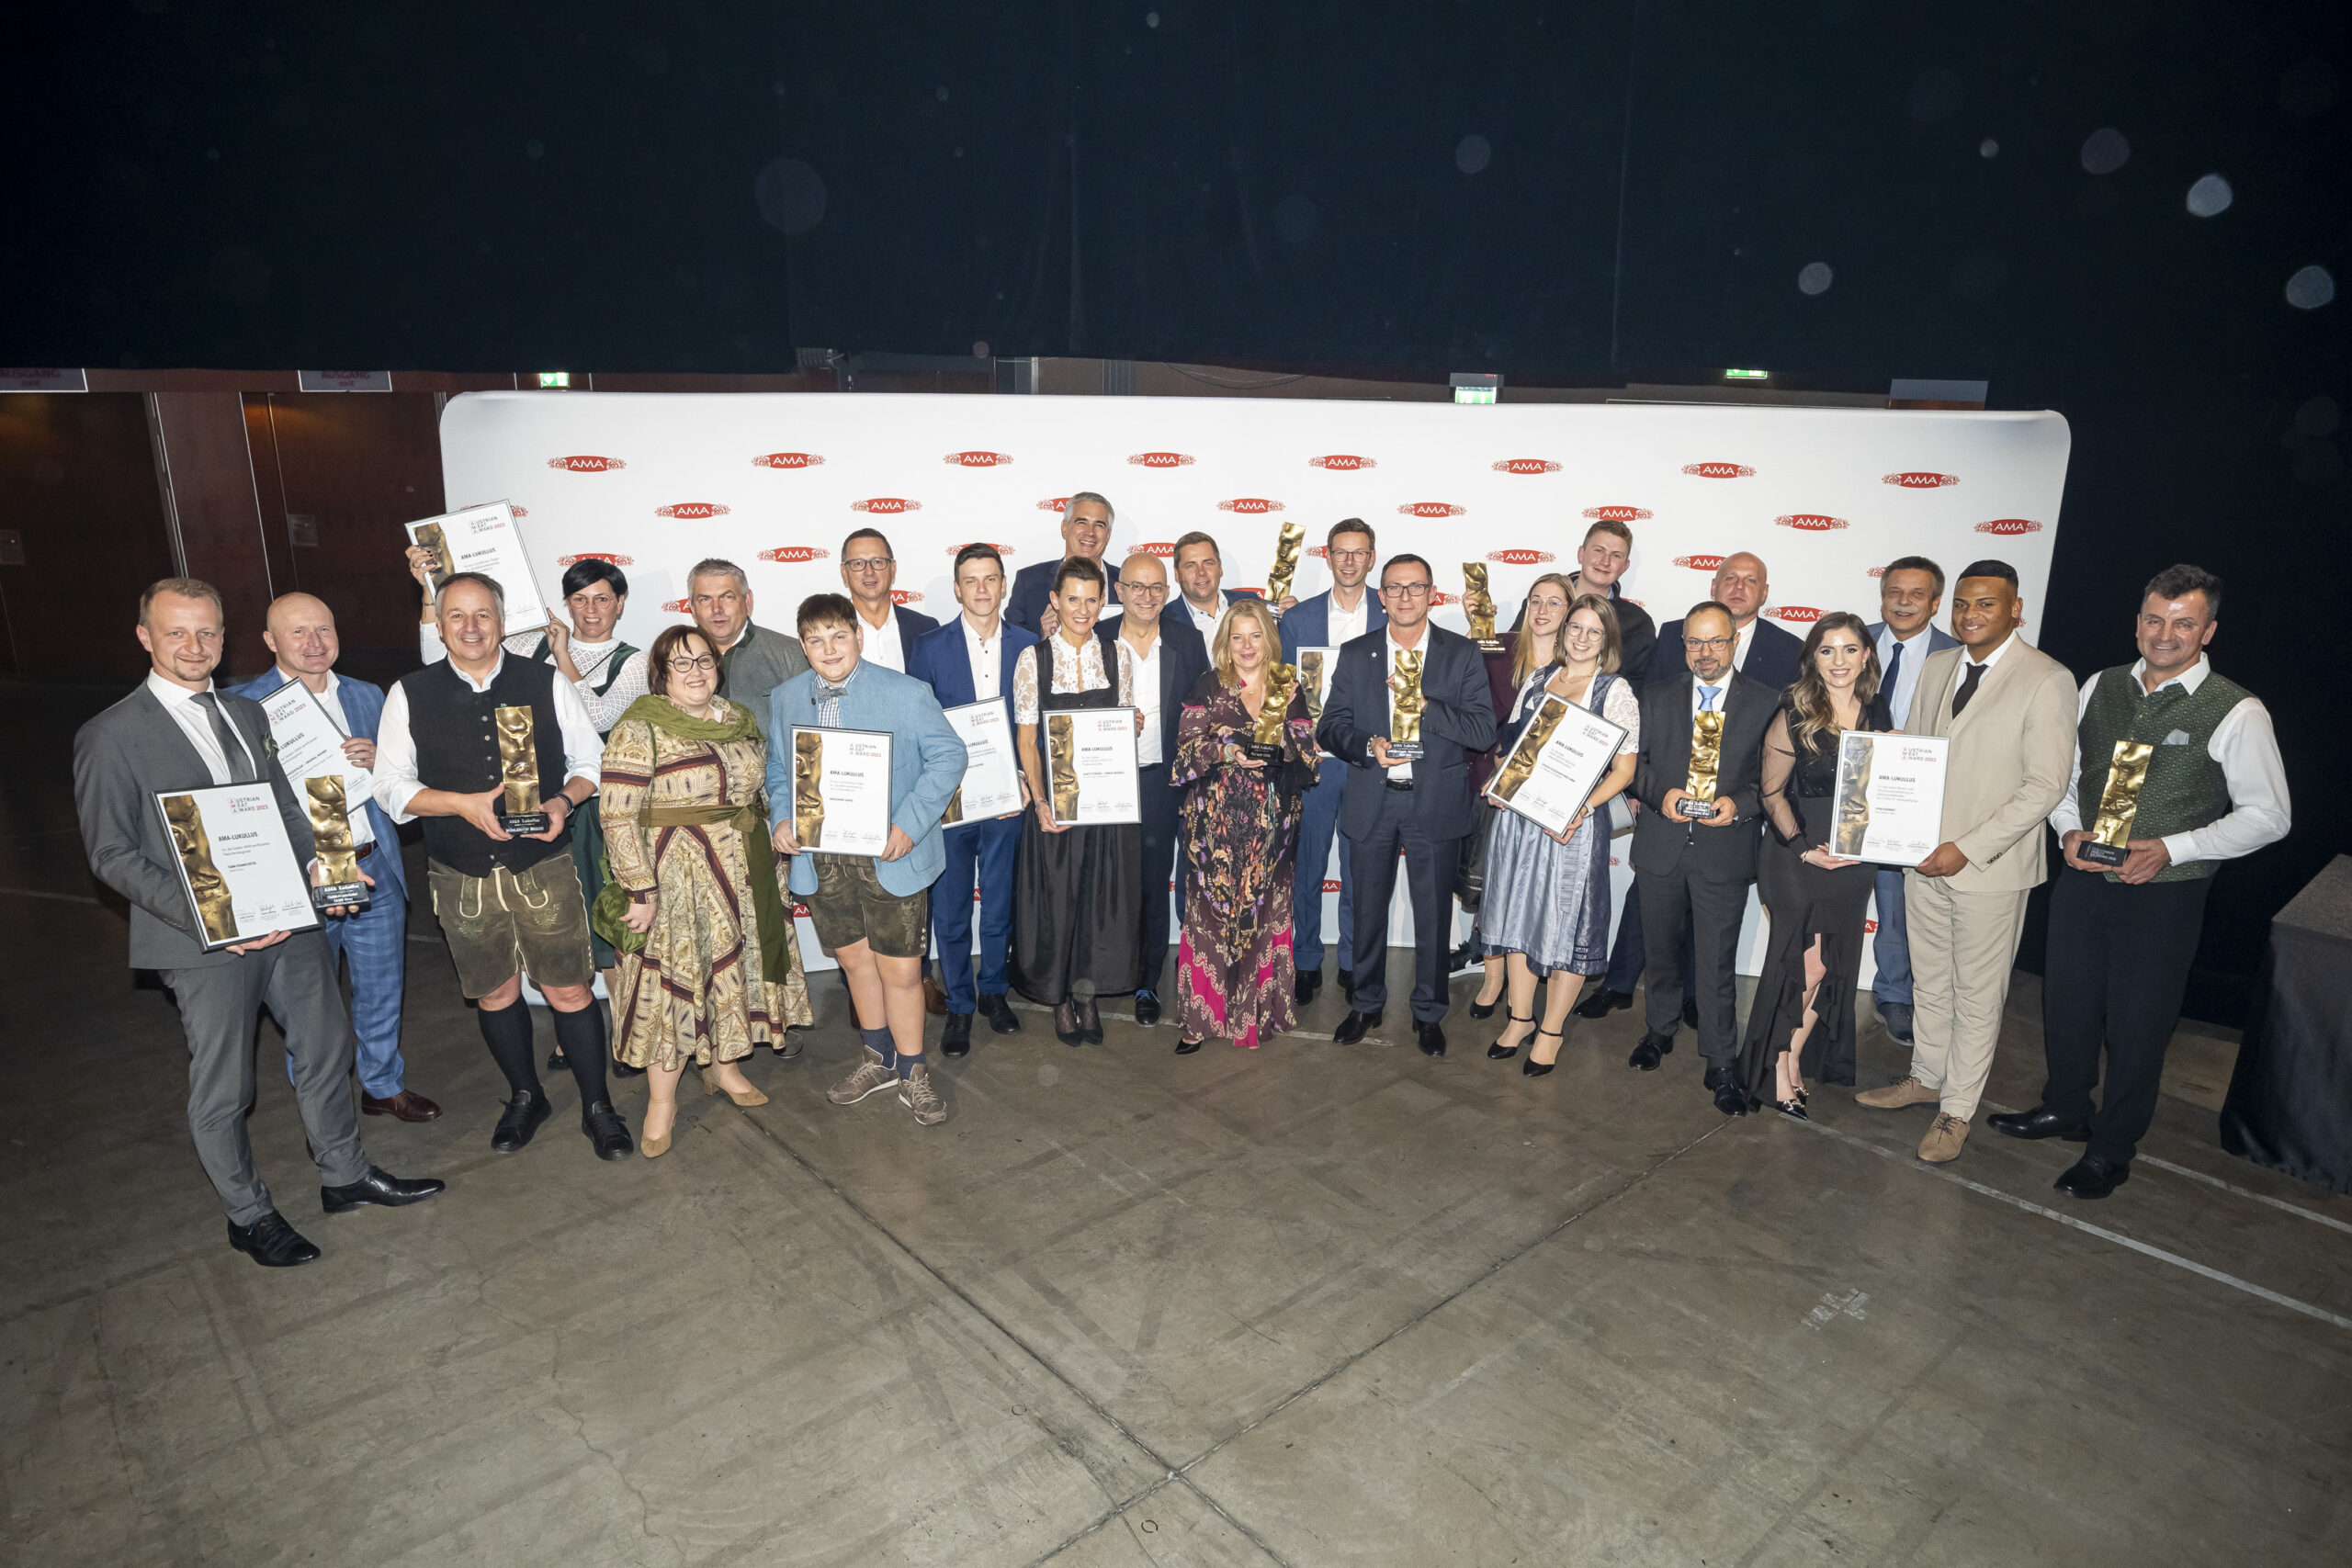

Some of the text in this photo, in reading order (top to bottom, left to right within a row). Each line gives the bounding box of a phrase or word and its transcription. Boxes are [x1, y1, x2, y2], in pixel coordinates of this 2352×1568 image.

[570, 459, 604, 468] AMA
[773, 456, 805, 465] AMA
[963, 455, 994, 463] AMA
[1146, 455, 1176, 464] AMA
[1328, 458, 1358, 467] AMA
[1511, 462, 1542, 471] AMA
[1702, 466, 1735, 475] AMA
[1903, 475, 1937, 485] AMA
[871, 501, 902, 510] AMA
[1236, 502, 1266, 510] AMA
[1416, 505, 1447, 514] AMA
[676, 506, 709, 515] AMA
[1602, 509, 1634, 518] AMA
[1795, 518, 1828, 527] AMA
[1994, 523, 2024, 531] AMA
[778, 550, 810, 559] AMA
[1505, 553, 1536, 561] AMA
[890, 593, 905, 602] MA
[1783, 609, 1815, 619] AMA
